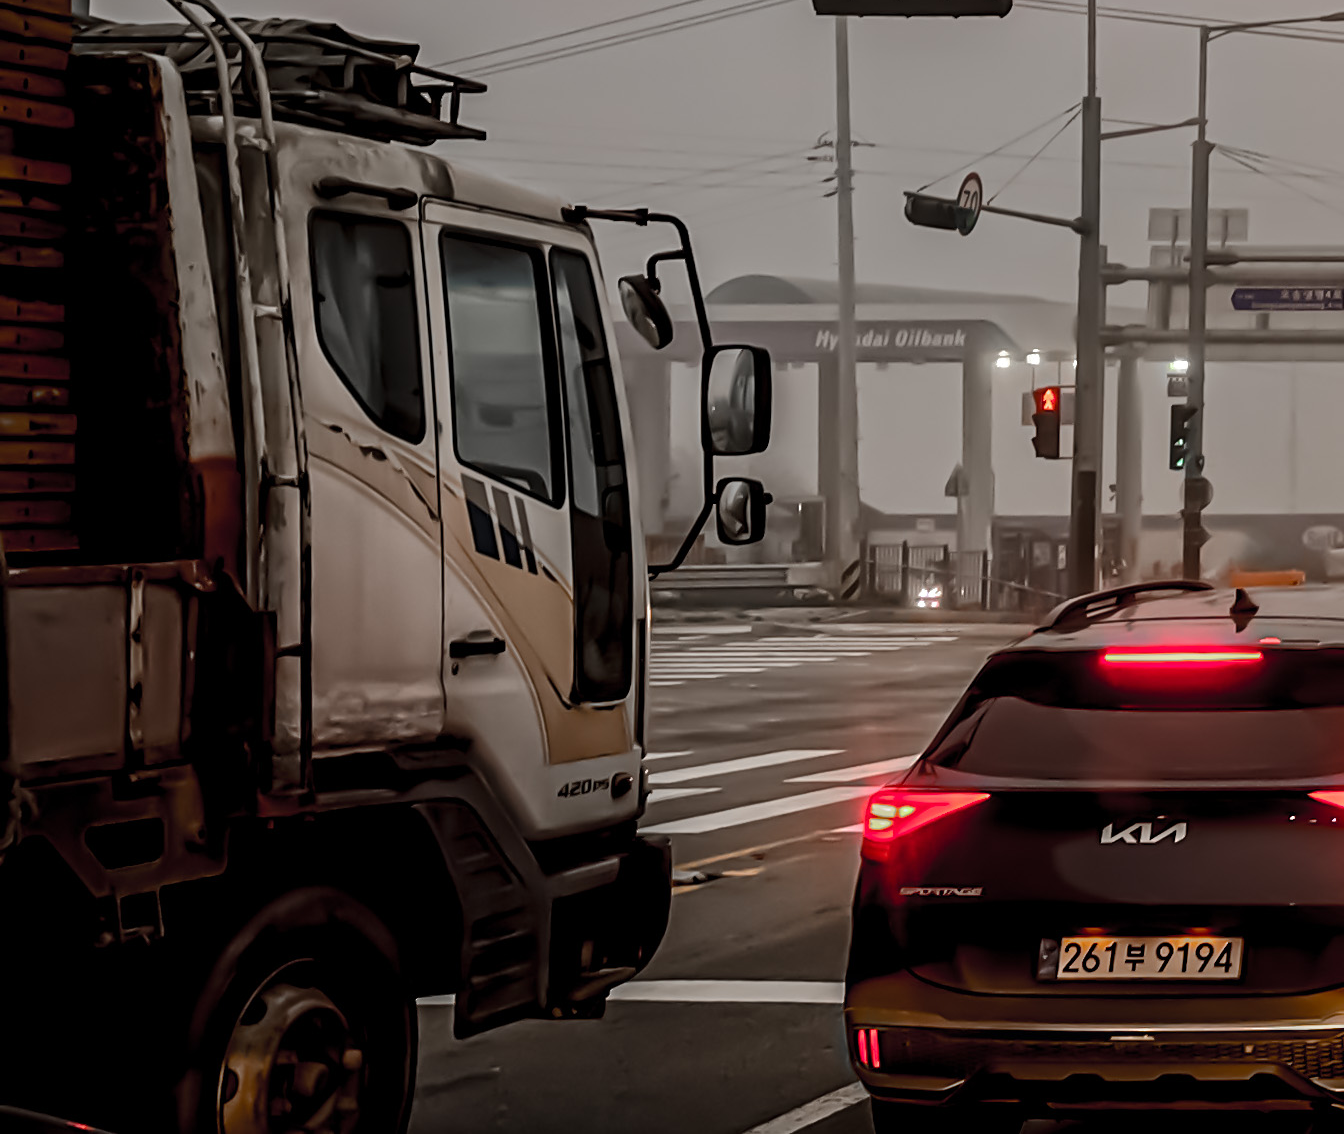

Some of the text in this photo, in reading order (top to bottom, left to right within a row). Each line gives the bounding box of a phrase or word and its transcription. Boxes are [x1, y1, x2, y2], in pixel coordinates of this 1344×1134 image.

[815, 329, 967, 351] Hydai Oilbank
[1100, 822, 1188, 845] KIA
[1155, 942, 1233, 973] 9194
